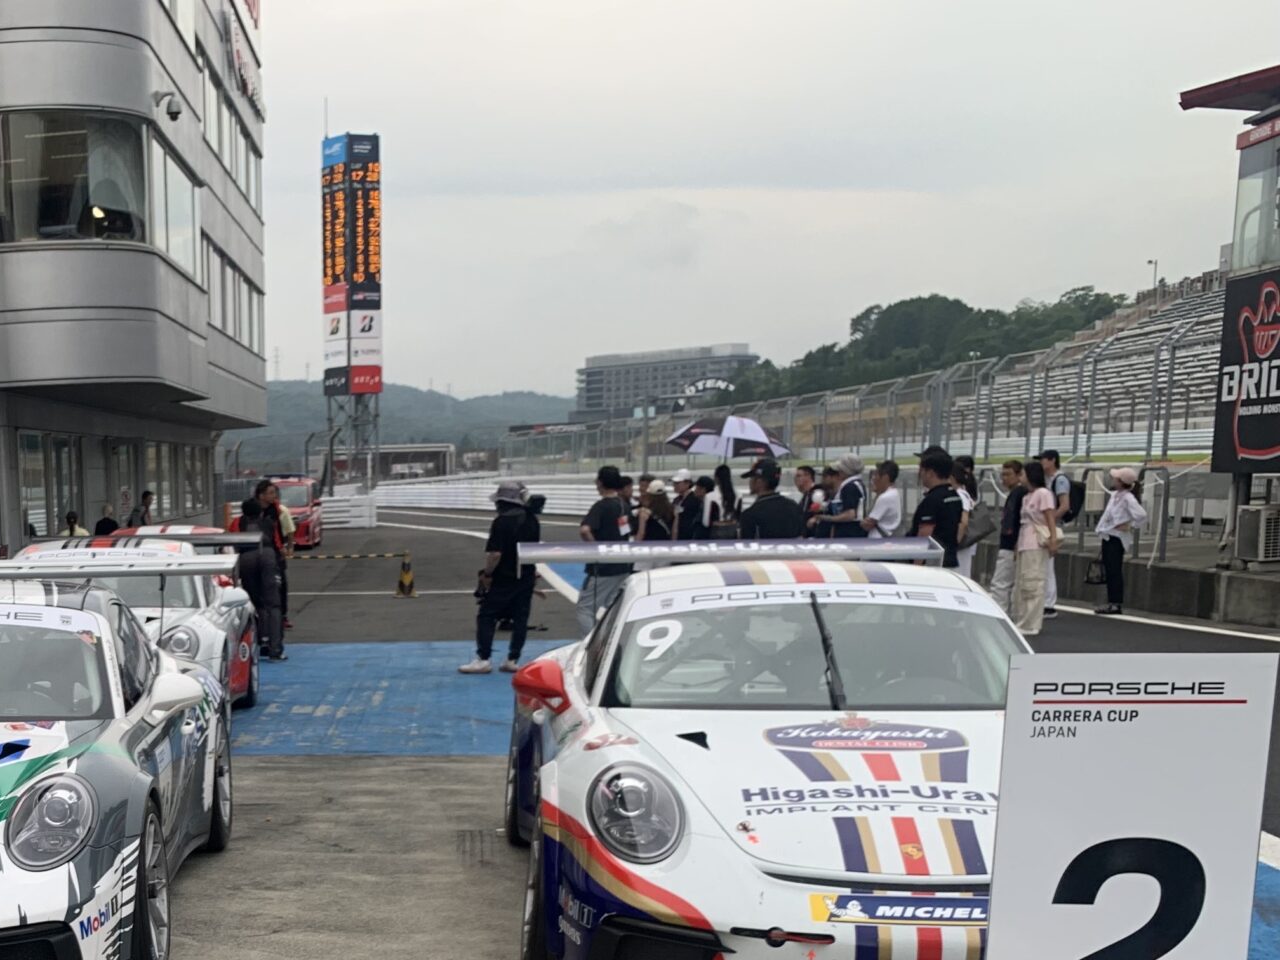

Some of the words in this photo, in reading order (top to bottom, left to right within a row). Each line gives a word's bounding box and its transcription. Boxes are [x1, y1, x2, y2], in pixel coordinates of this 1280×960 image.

[691, 590, 939, 604] PORSCHE
[635, 619, 683, 662] 9
[1033, 682, 1226, 695] PORSCHE
[1031, 710, 1103, 722] CARRERA
[1107, 710, 1139, 722] CUP
[777, 727, 949, 741] Kobayashi
[1030, 726, 1077, 738] JAPAN
[745, 804, 902, 816] IMPLANT
[79, 901, 111, 940] Mobil
